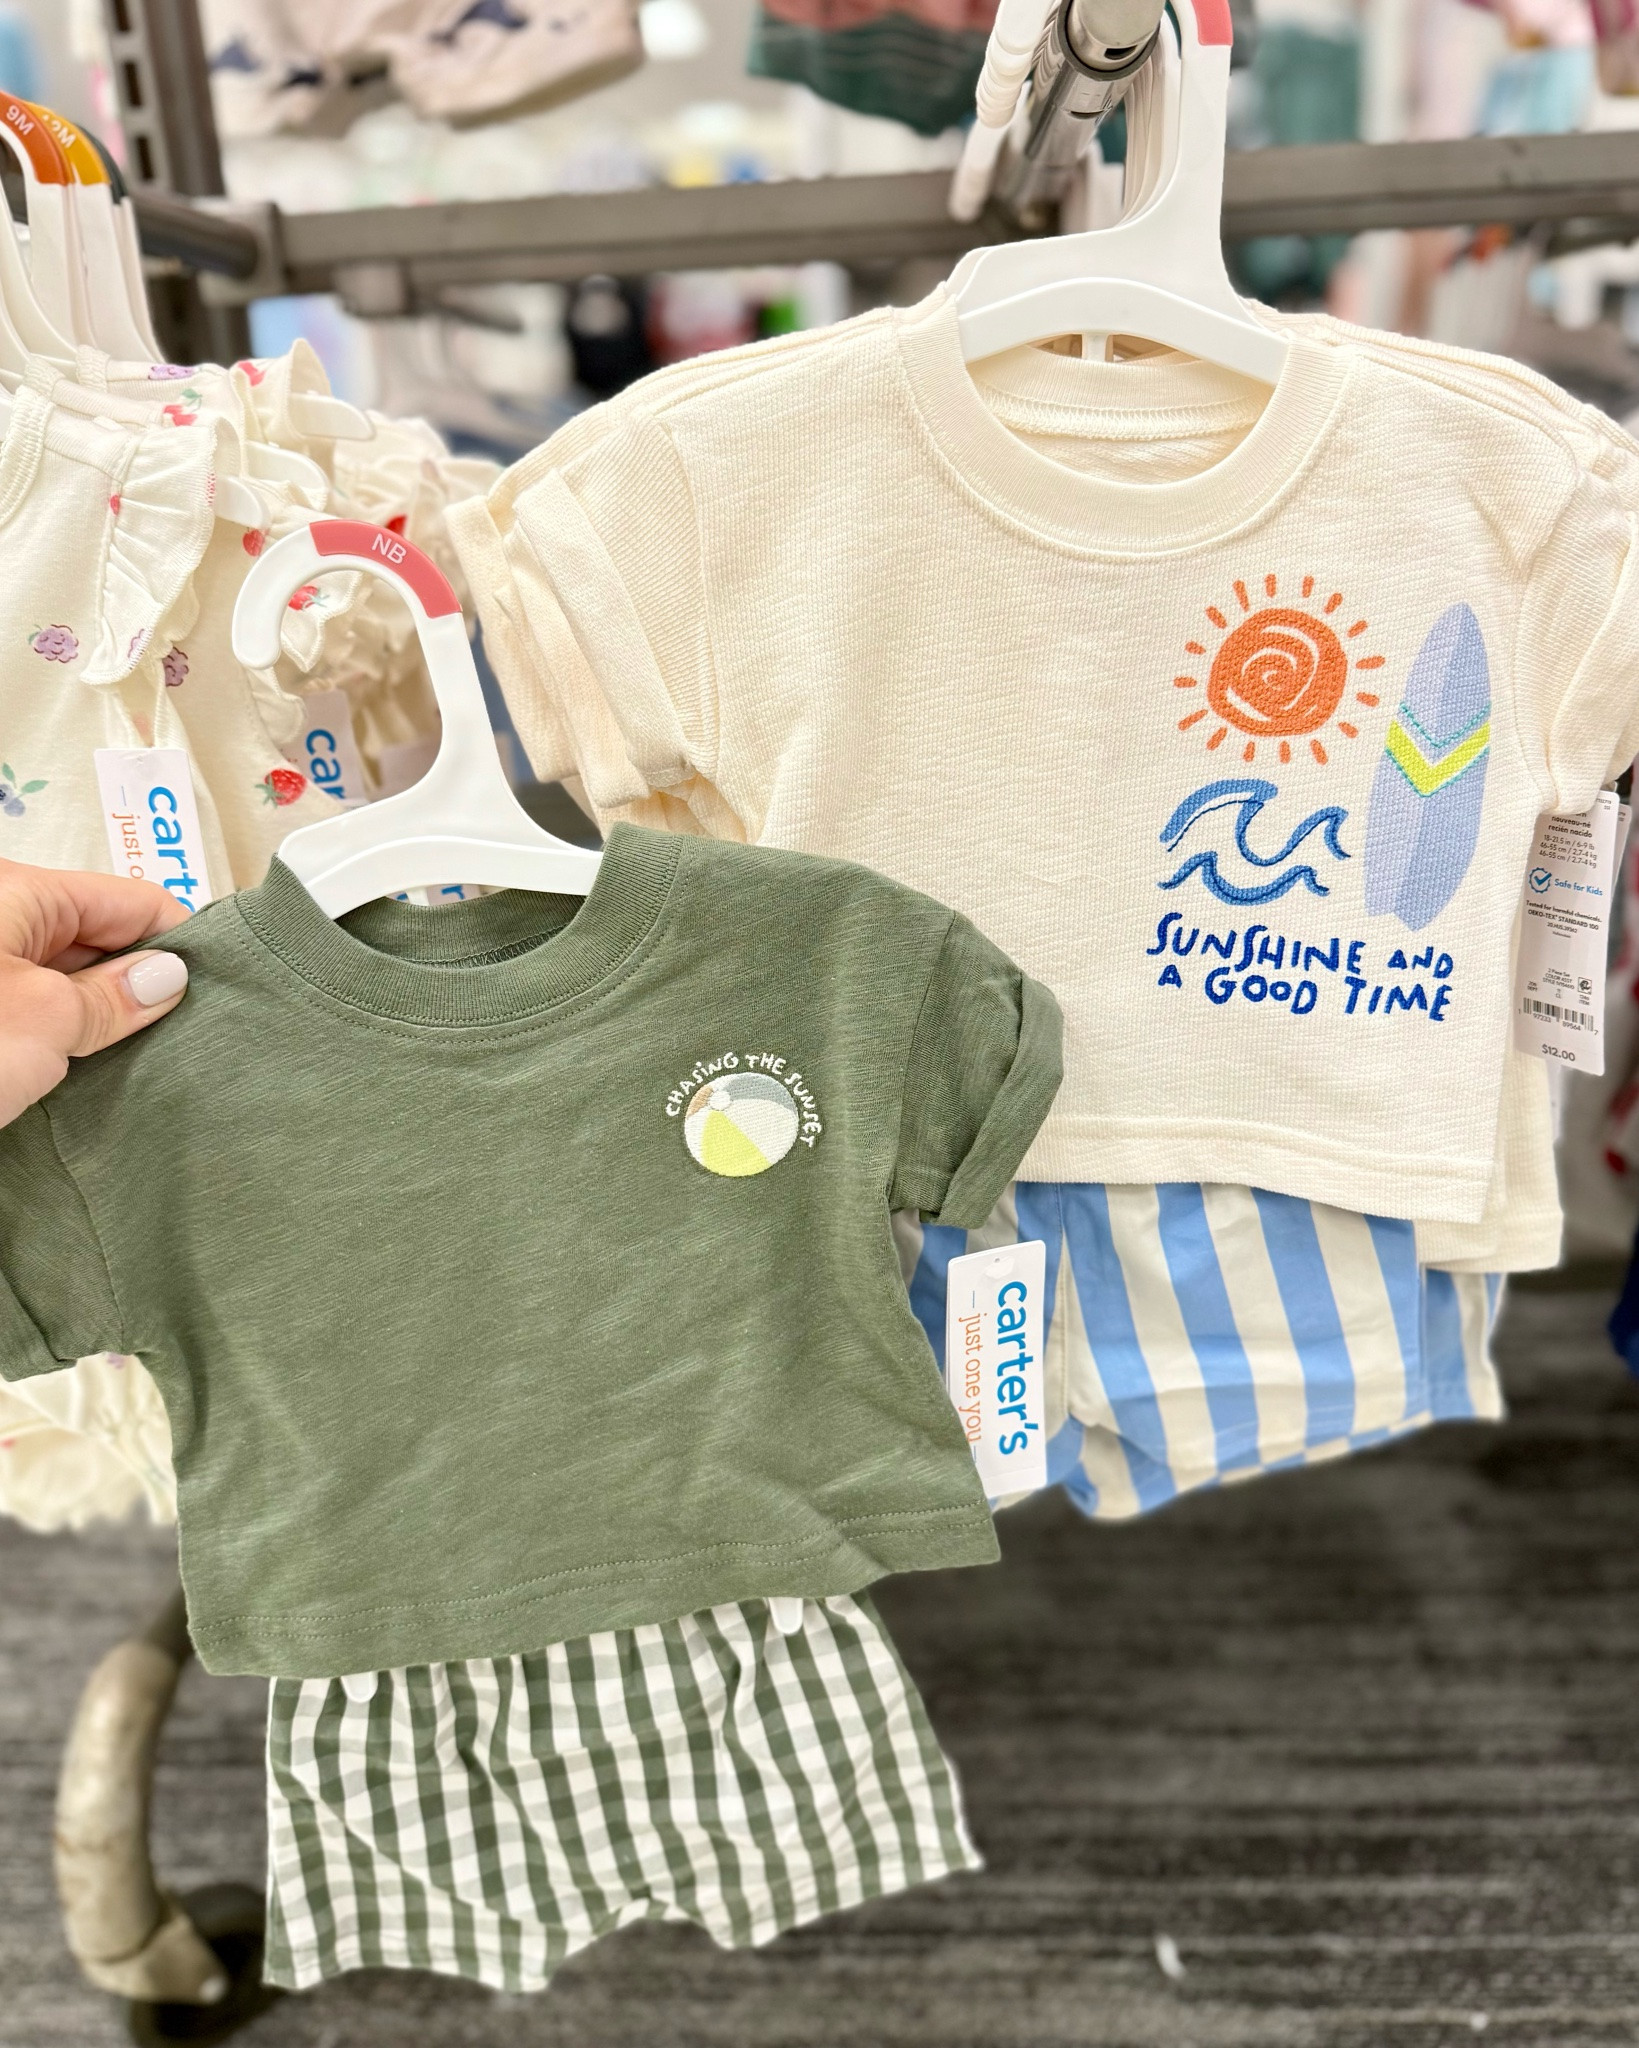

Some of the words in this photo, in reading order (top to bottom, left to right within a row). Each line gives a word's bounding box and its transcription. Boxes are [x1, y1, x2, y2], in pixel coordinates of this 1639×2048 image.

[6, 105, 35, 136] 9M
[371, 533, 407, 564] NB
[112, 813, 144, 859] just
[1548, 824, 1569, 834] recién
[1570, 828, 1593, 838] nacido
[1551, 816, 1591, 828] nouveau-né
[1588, 859, 1597, 868] kg
[1589, 851, 1597, 860] kg
[1554, 878, 1572, 889] Safe
[1573, 882, 1585, 892] for
[1586, 885, 1603, 896] Kids
[1526, 900, 1543, 909] Tested
[1552, 905, 1574, 916] harmful
[1558, 916, 1588, 928] STANDARD
[1588, 922, 1599, 930] 100
[1146, 912, 1366, 975] SUNSHINE
[1387, 946, 1454, 979] AND
[1157, 964, 1182, 989] A
[1204, 966, 1318, 1015] GOOD
[1344, 976, 1453, 1022] TIME
[1541, 1043, 1576, 1062] $12.00
[744, 1052, 787, 1075] THE
[783, 1072, 822, 1148] SUNSET
[958, 1312, 988, 1356] just
[965, 1358, 981, 1398] one
[996, 1281, 1039, 1455] carter's
[958, 1401, 982, 1443] you
